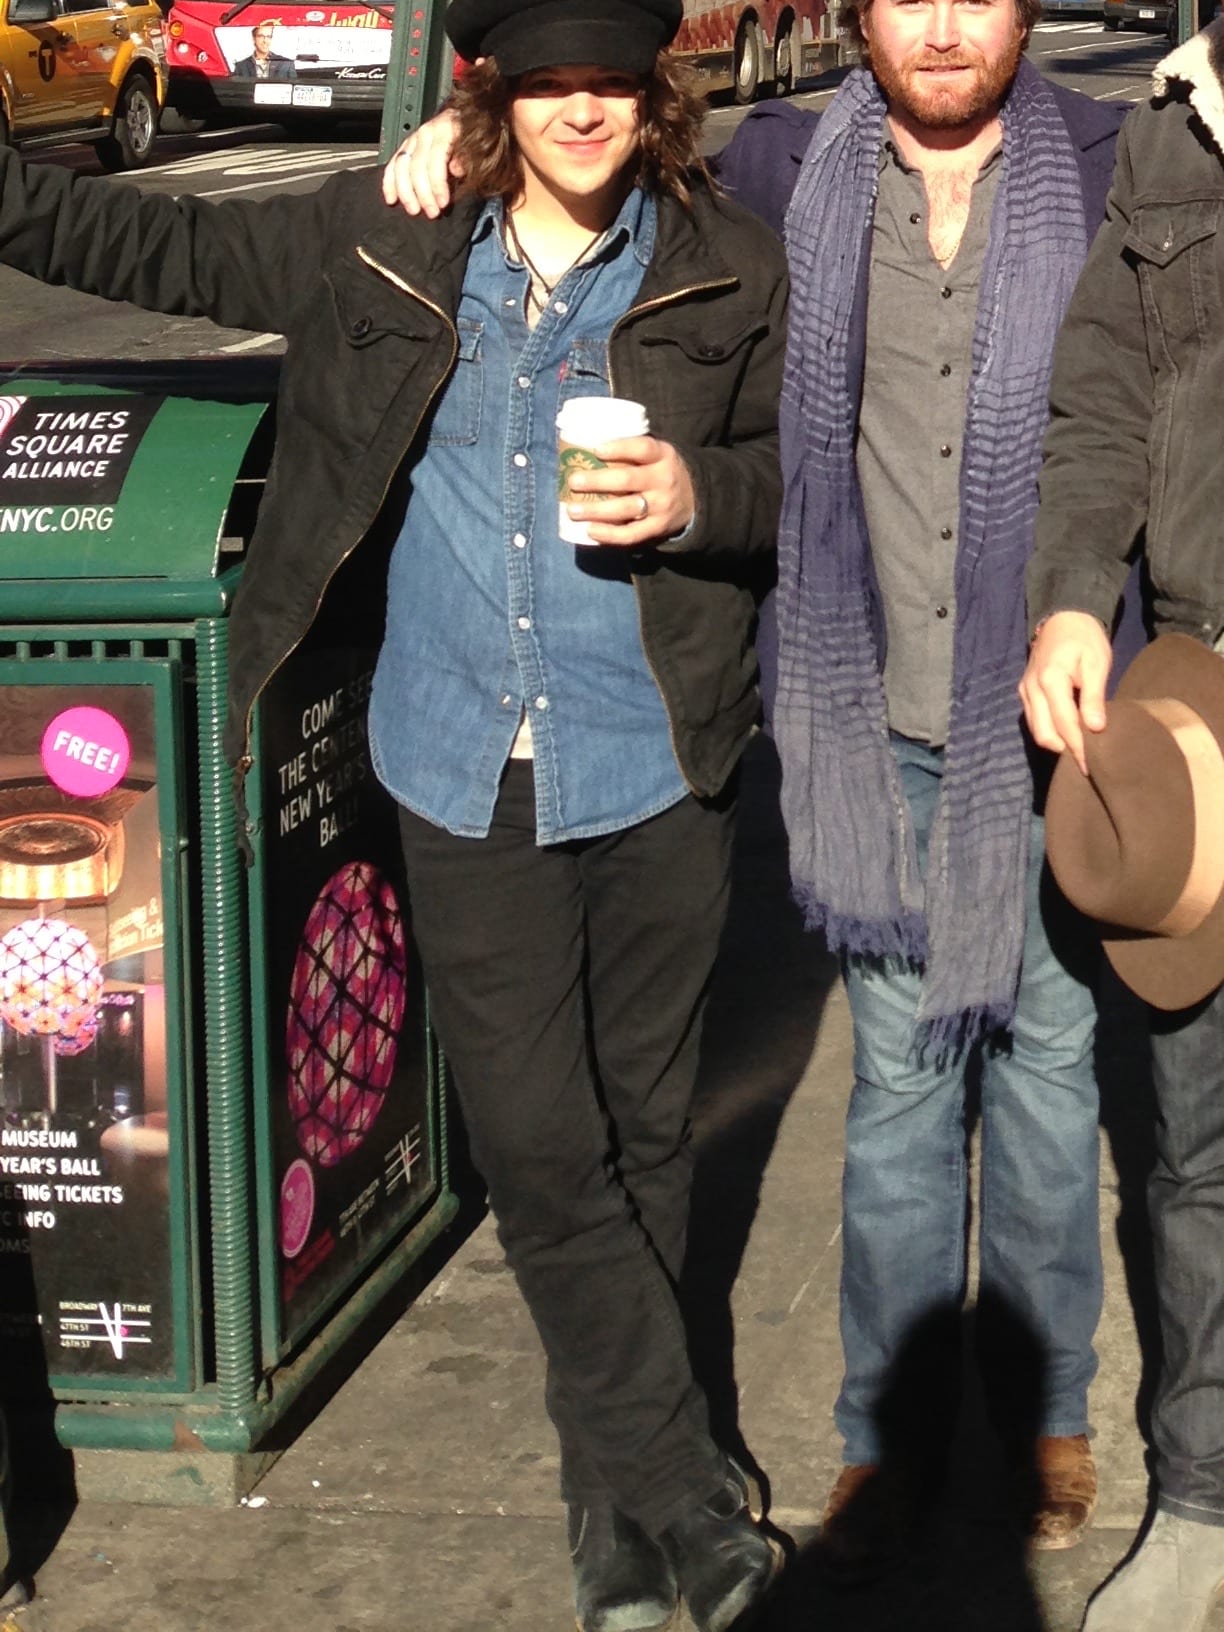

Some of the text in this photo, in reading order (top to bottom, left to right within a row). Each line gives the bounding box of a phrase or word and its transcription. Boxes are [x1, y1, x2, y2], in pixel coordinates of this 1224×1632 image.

[34, 411, 129, 431] TIMES
[6, 433, 129, 459] SQUARE
[2, 460, 110, 479] ALLIANCE
[0, 506, 114, 533] NYC.ORG
[302, 689, 343, 739] COME
[53, 731, 120, 775] FREE!
[278, 751, 307, 795] THE
[279, 789, 312, 837] NEW
[2, 1130, 77, 1148] MUSEUM
[0, 1157, 101, 1176] YEAR'S BALL
[54, 1185, 123, 1204] TICKETS
[18, 1211, 56, 1229] INFO
